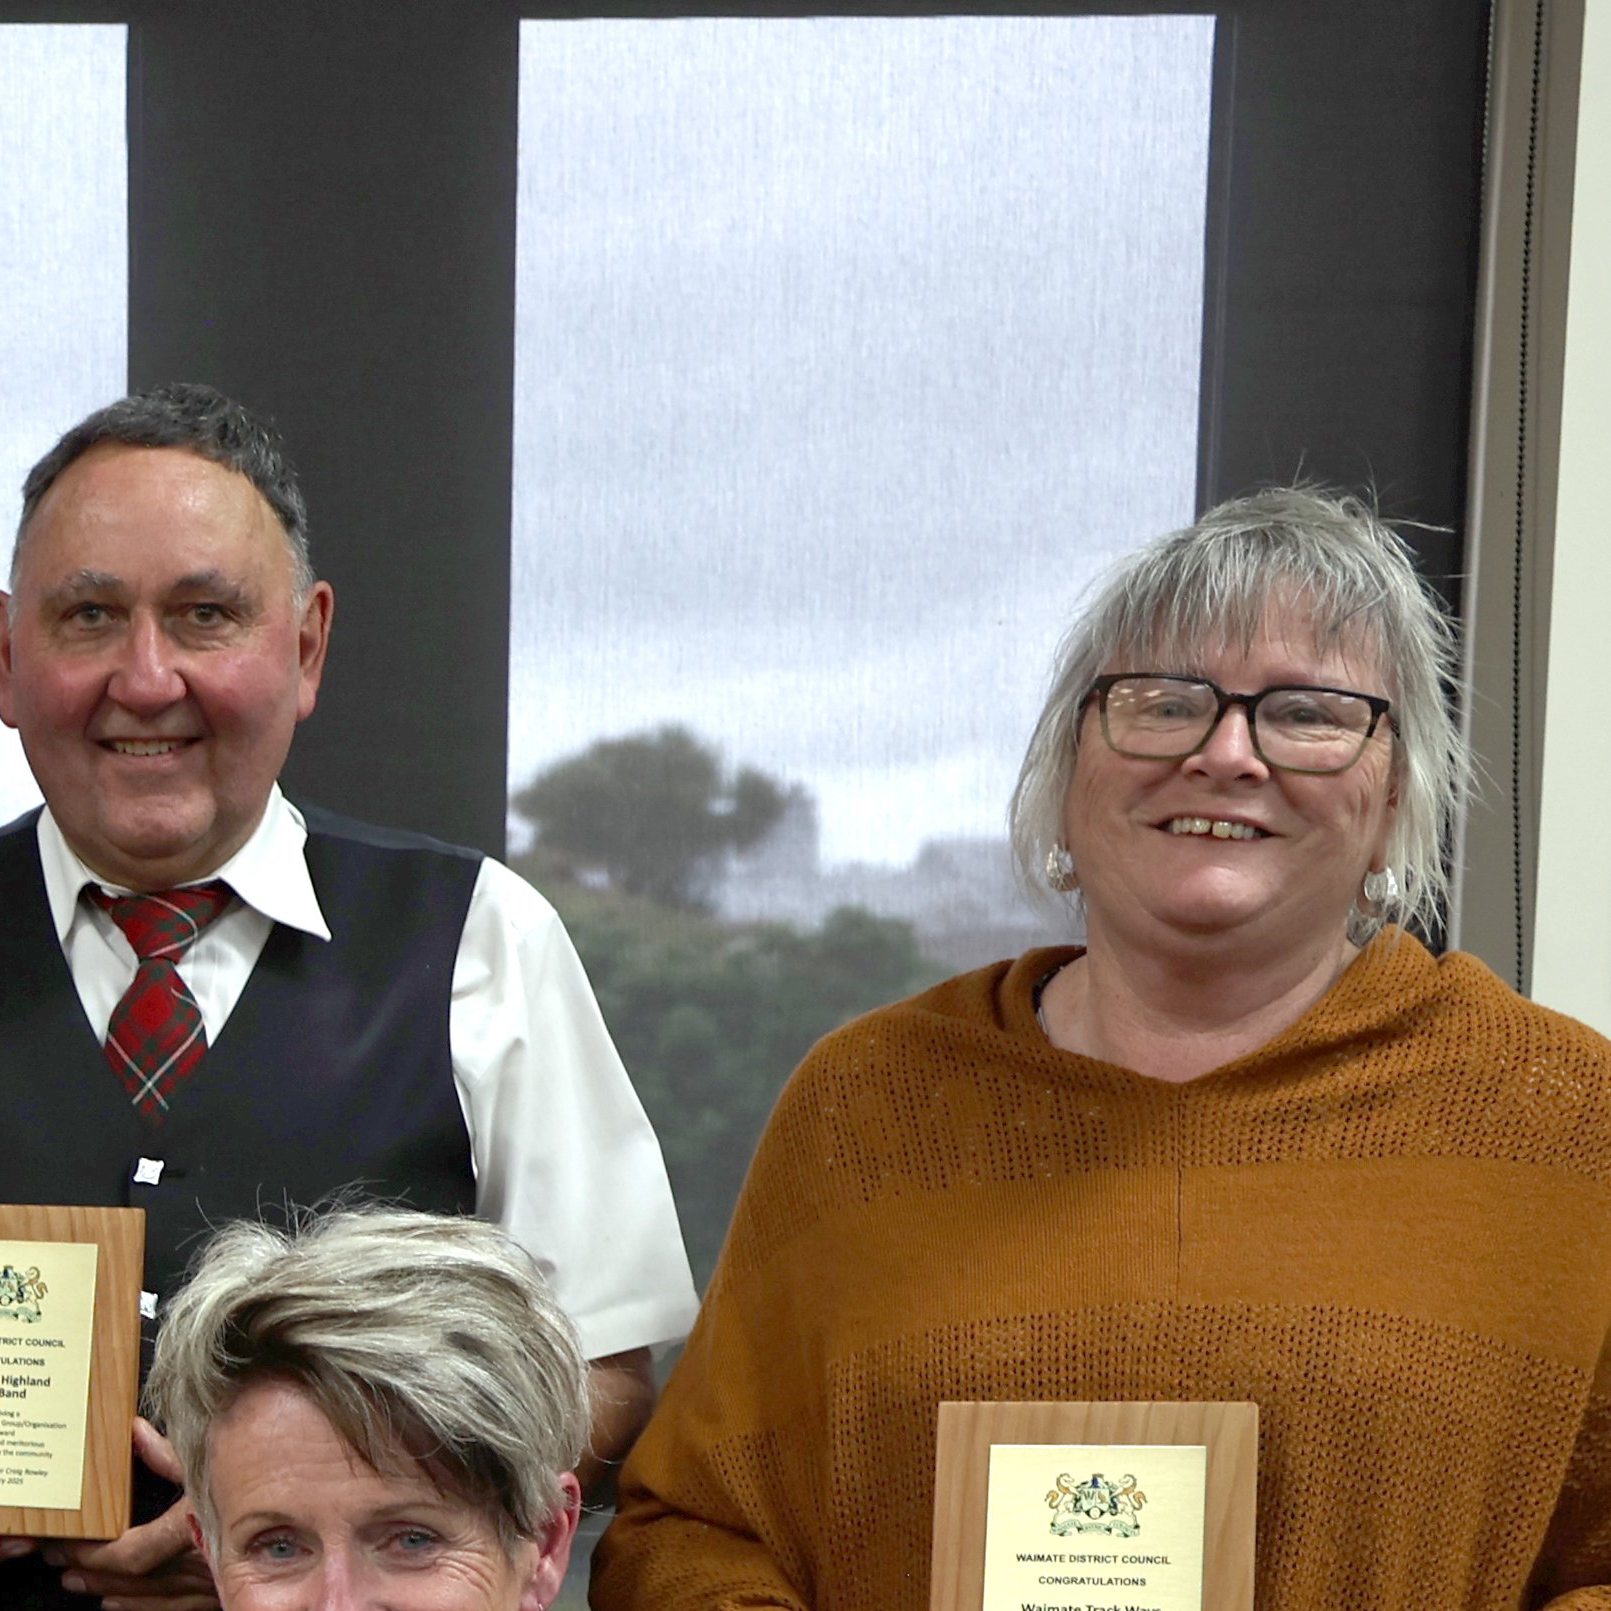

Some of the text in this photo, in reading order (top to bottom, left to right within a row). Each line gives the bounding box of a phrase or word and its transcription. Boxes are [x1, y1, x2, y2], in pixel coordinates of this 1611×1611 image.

[25, 1338, 65, 1348] COUNCIL
[1, 1375, 51, 1388] Highland
[1016, 1554, 1171, 1565] WAIMATE DISTRICT COUNCIL
[1038, 1576, 1146, 1586] CONGRATULATIONS
